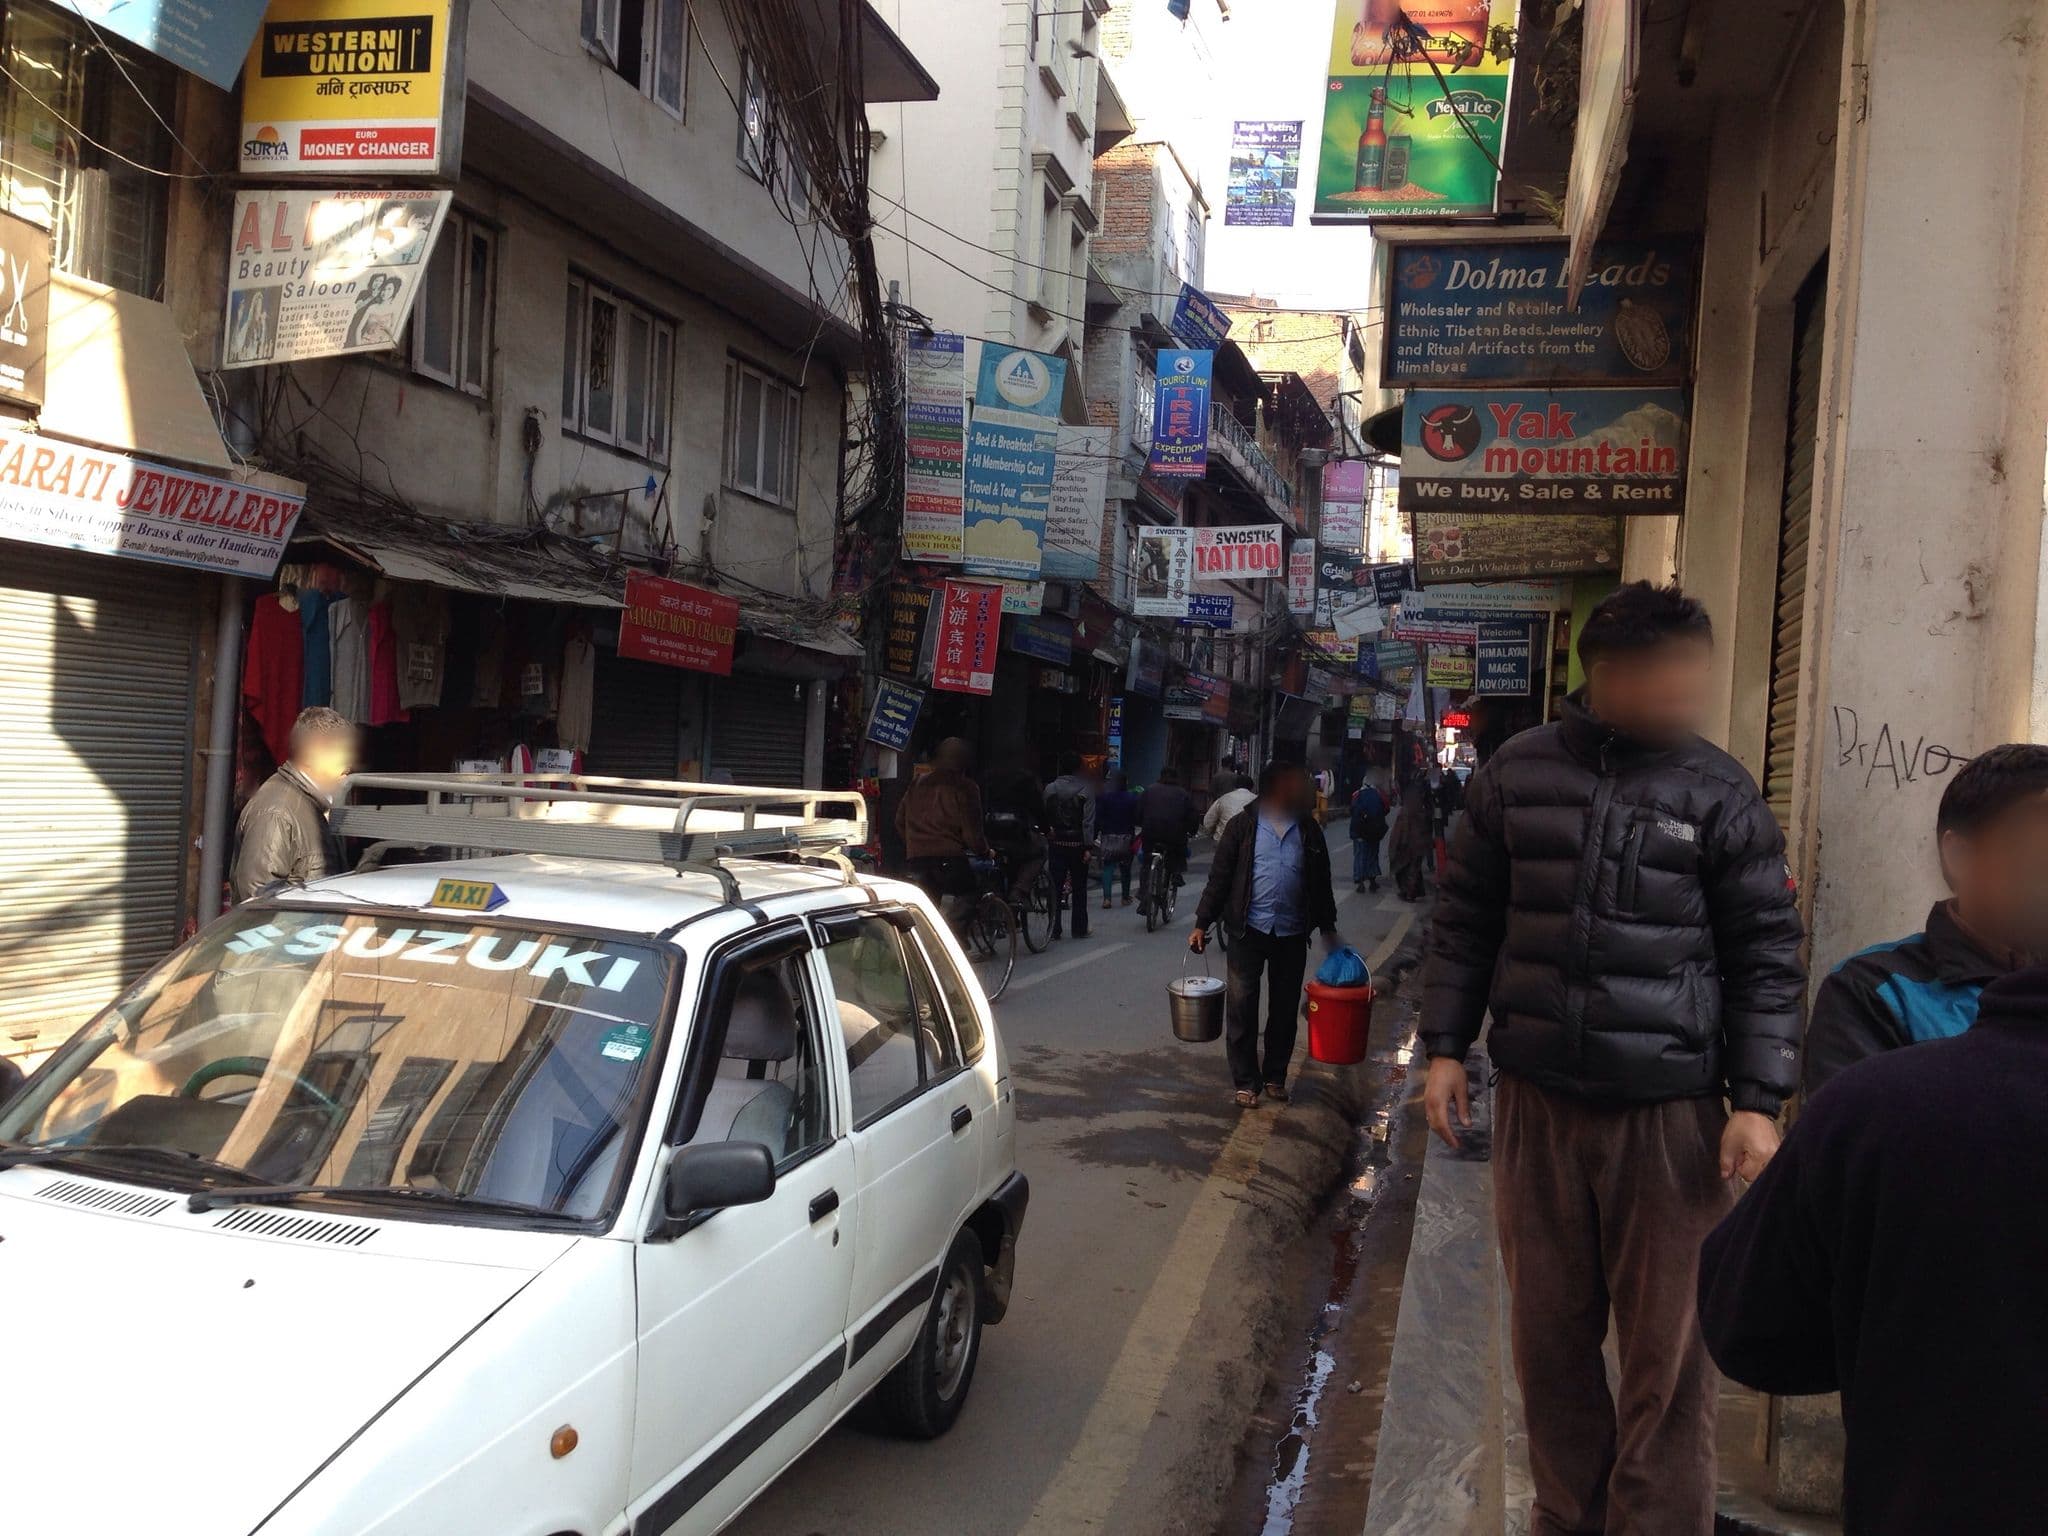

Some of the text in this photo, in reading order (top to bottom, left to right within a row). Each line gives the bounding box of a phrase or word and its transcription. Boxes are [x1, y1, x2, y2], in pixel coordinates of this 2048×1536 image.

[274, 29, 397, 54] WESTERN
[309, 52, 396, 74] UNION
[316, 77, 344, 96] मनि
[1473, 101, 1492, 114] Ice
[355, 131, 378, 139] EURO
[243, 140, 289, 156] SURYA
[304, 142, 429, 156] MONEY CHANGER
[334, 192, 349, 200] AT
[352, 192, 392, 200] GROUND
[1367, 207, 1398, 215] Natural
[1399, 207, 1411, 215] All
[1412, 207, 1438, 215] Barley
[238, 256, 310, 280] Beauty
[1445, 249, 1670, 291] Dolma ads
[283, 280, 356, 299] Saloon
[280, 312, 310, 323] Ladies
[322, 309, 350, 319] Gents
[1400, 302, 1471, 317] Wholesaler
[1476, 302, 1502, 316] and
[1507, 302, 1563, 316] Retailer
[1399, 324, 1440, 338] Ethnic
[1445, 324, 1500, 338] Tibetan
[1546, 323, 1604, 338] Jewellery
[1398, 341, 1596, 356] and Ritual Artifacts from the
[1396, 360, 1468, 375] Himalayas
[1158, 375, 1208, 388] TOURIST LINK
[909, 404, 962, 416] PANORAMA
[1168, 386, 1193, 438] TREK
[909, 413, 962, 424] DENTAL CLINIC
[1488, 402, 1576, 440] Yak
[976, 432, 1033, 453] Bed & Breakfast
[1154, 442, 1204, 454] EXPEDITION
[941, 445, 963, 458] Cyber
[1484, 438, 1676, 474] mountain
[972, 453, 1045, 476] HI Membership Card
[1178, 455, 1193, 463] Ltd.
[908, 468, 933, 476] travels
[941, 470, 961, 478] tours
[1055, 474, 1086, 484] Trekking
[0, 438, 300, 540] ARATI JEWELLERY
[969, 480, 1017, 498] Travel & Tour
[1052, 484, 1088, 494] Expedition
[1416, 482, 1674, 502] We buy, Sale & Rent
[1053, 494, 1066, 504] City
[1054, 505, 1081, 516] Rafting
[1068, 516, 1088, 525] Safari
[49, 506, 83, 522] Silver
[136, 520, 170, 539] Brass
[172, 529, 184, 542] &
[186, 532, 218, 548] other
[218, 538, 281, 560] Handicrafts
[1046, 526, 1085, 536] Paragliding
[1154, 528, 1188, 536] SWOSTIK
[1216, 530, 1277, 545] SWOSTIK
[122, 538, 148, 552] E-mail:
[905, 540, 961, 551] GUEST HOUSE
[1071, 538, 1092, 546] Flight
[1195, 543, 1281, 573] TATTOO
[1174, 538, 1188, 600] TATTOO
[1430, 566, 1447, 576] We
[1450, 564, 1474, 576] Deal
[1535, 561, 1546, 570] &
[1550, 558, 1584, 570] Export
[1003, 584, 1026, 595] Body
[1004, 596, 1028, 610] Spa
[1195, 606, 1230, 616] Pvt. Ltd.
[670, 613, 697, 640] MONEY
[698, 622, 736, 646] CHANGER
[947, 586, 970, 664] 龙游宾馆
[1482, 629, 1522, 638] Welcome
[1478, 646, 1528, 658] HIMALAYAN
[1430, 658, 1452, 670] Shree
[1488, 662, 1516, 674] MAGIC
[1656, 820, 1682, 833] NORTH
[438, 883, 488, 907] TAXI
[284, 924, 640, 993] SUZUKI
